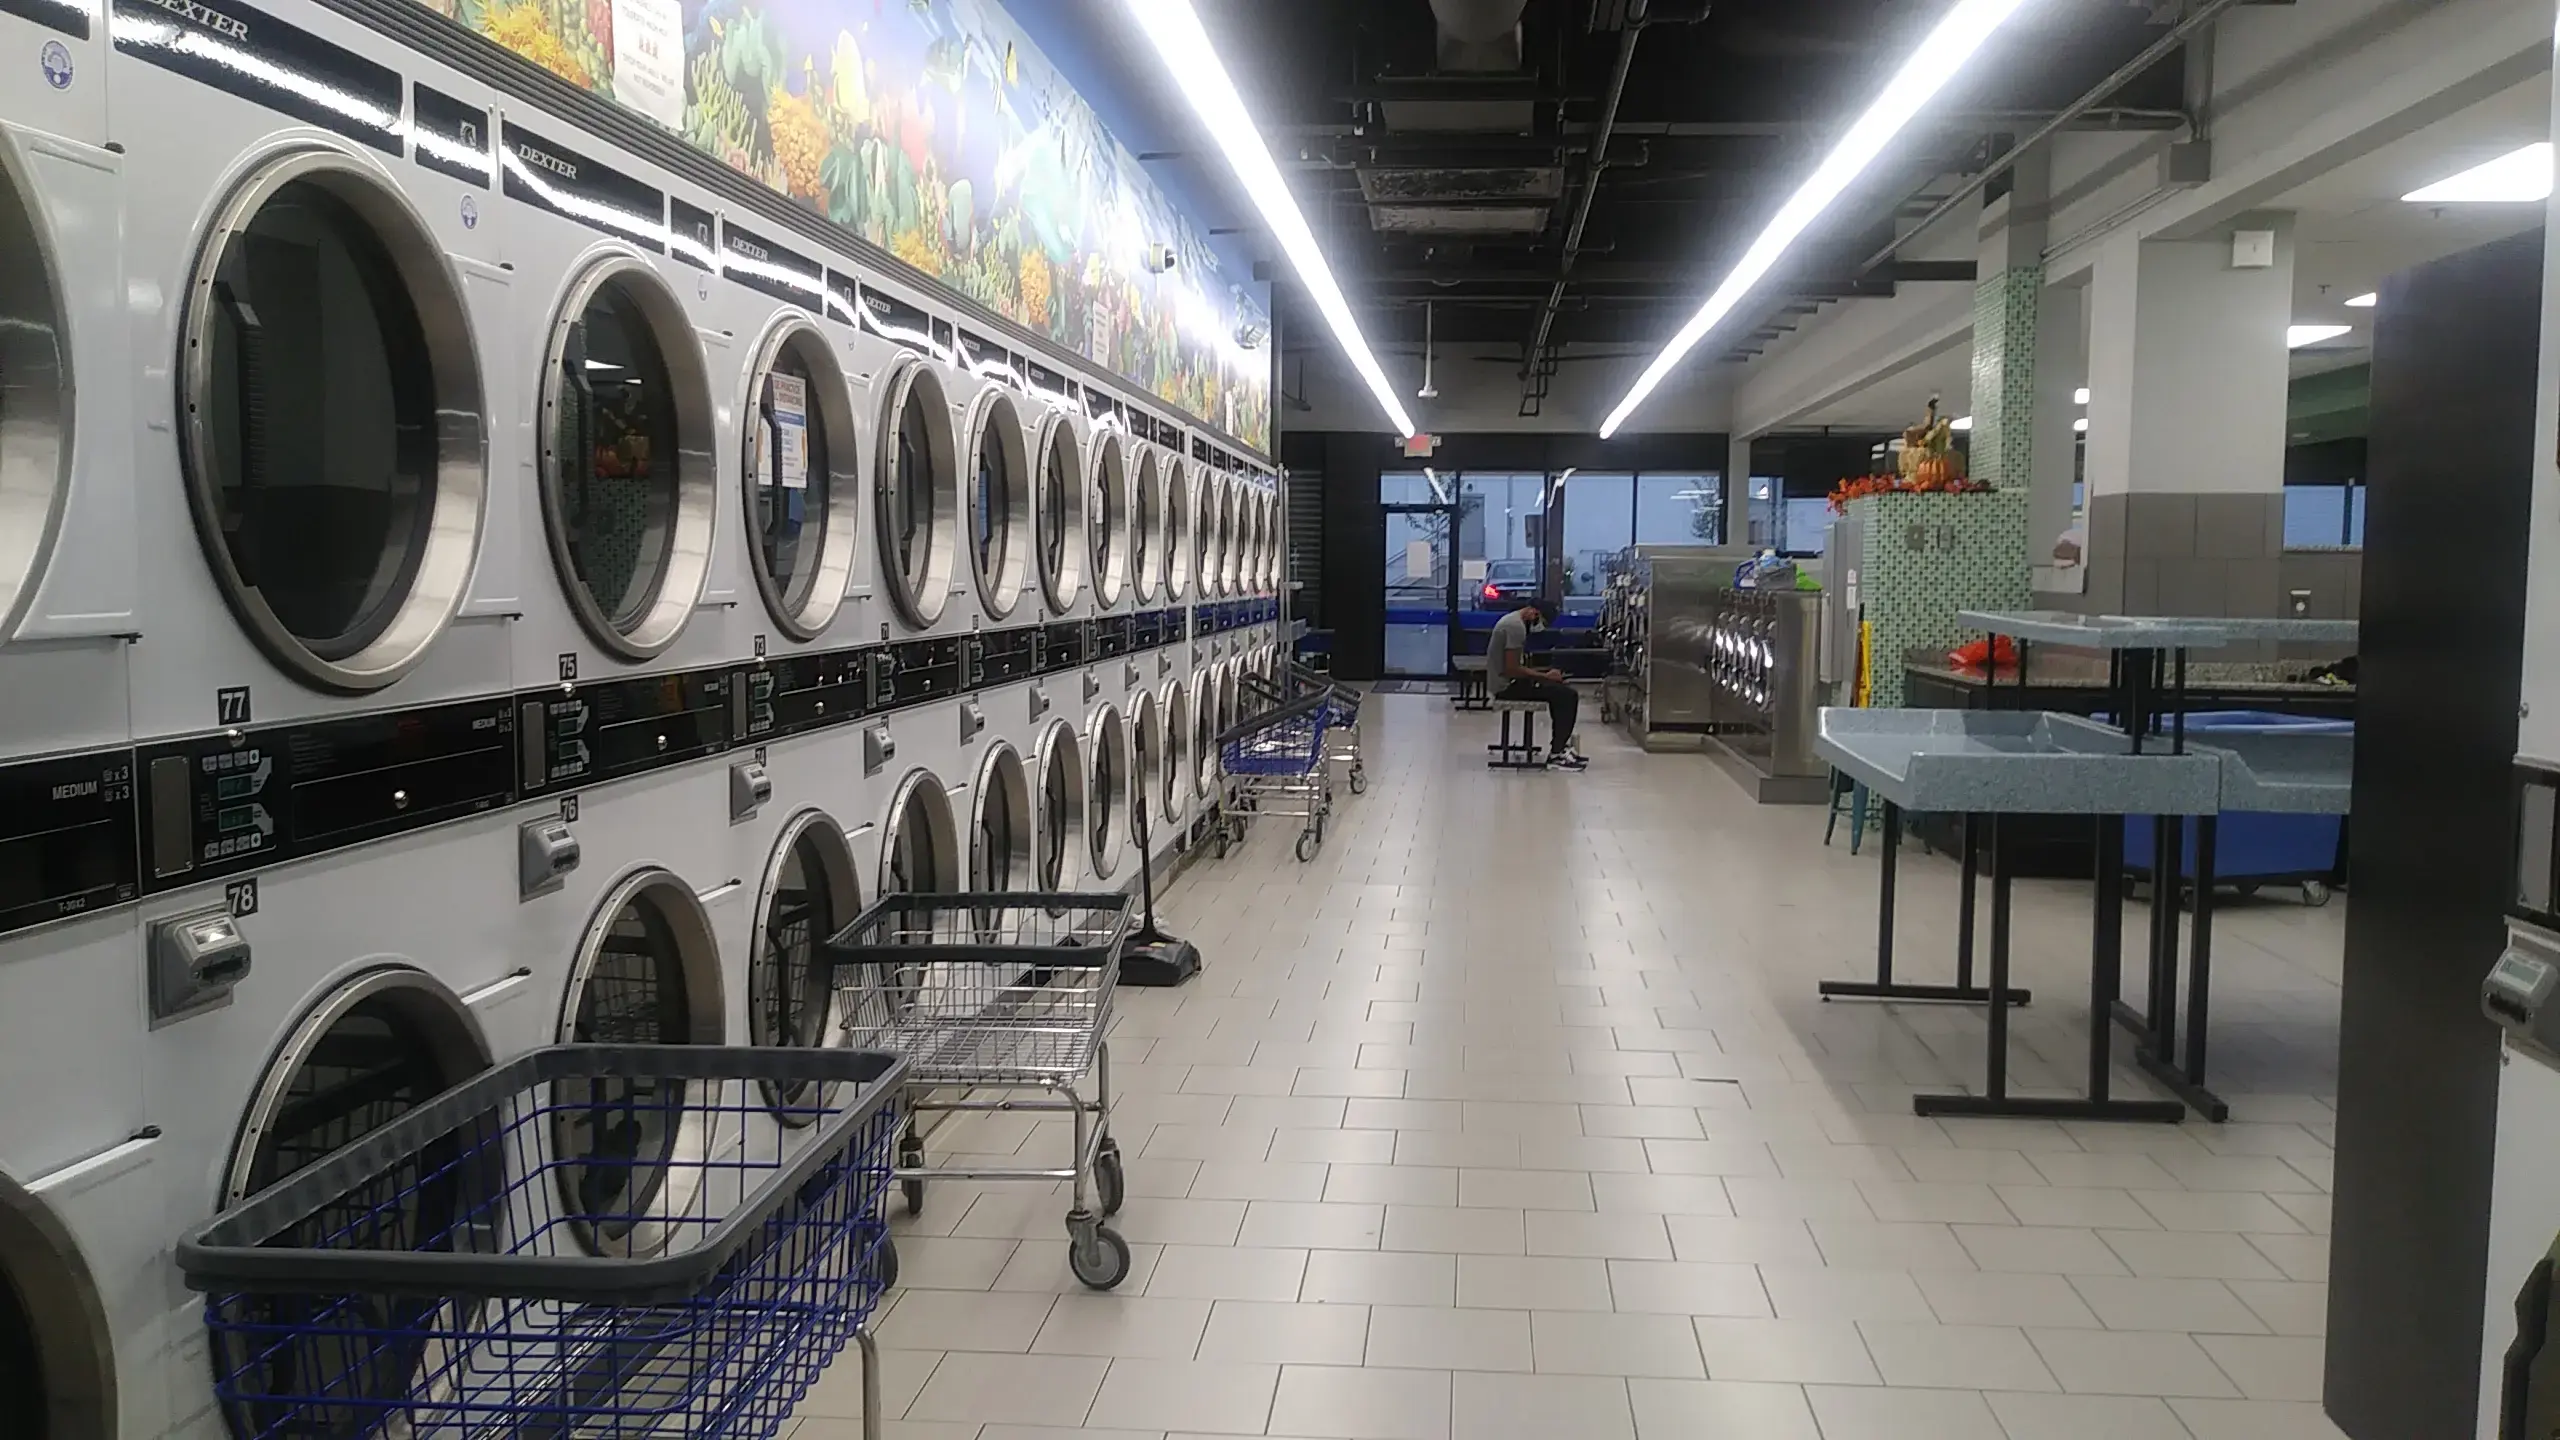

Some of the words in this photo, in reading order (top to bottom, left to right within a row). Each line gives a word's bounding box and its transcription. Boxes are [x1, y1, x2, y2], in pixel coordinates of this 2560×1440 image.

[148, 0, 248, 41] EXTER
[519, 143, 577, 180] DEXTER
[732, 236, 768, 261] DEXTER
[560, 655, 575, 678] 75
[221, 691, 246, 720] 77
[52, 780, 98, 801] MEDIUM
[561, 799, 576, 821] 76
[228, 884, 254, 917] 78
